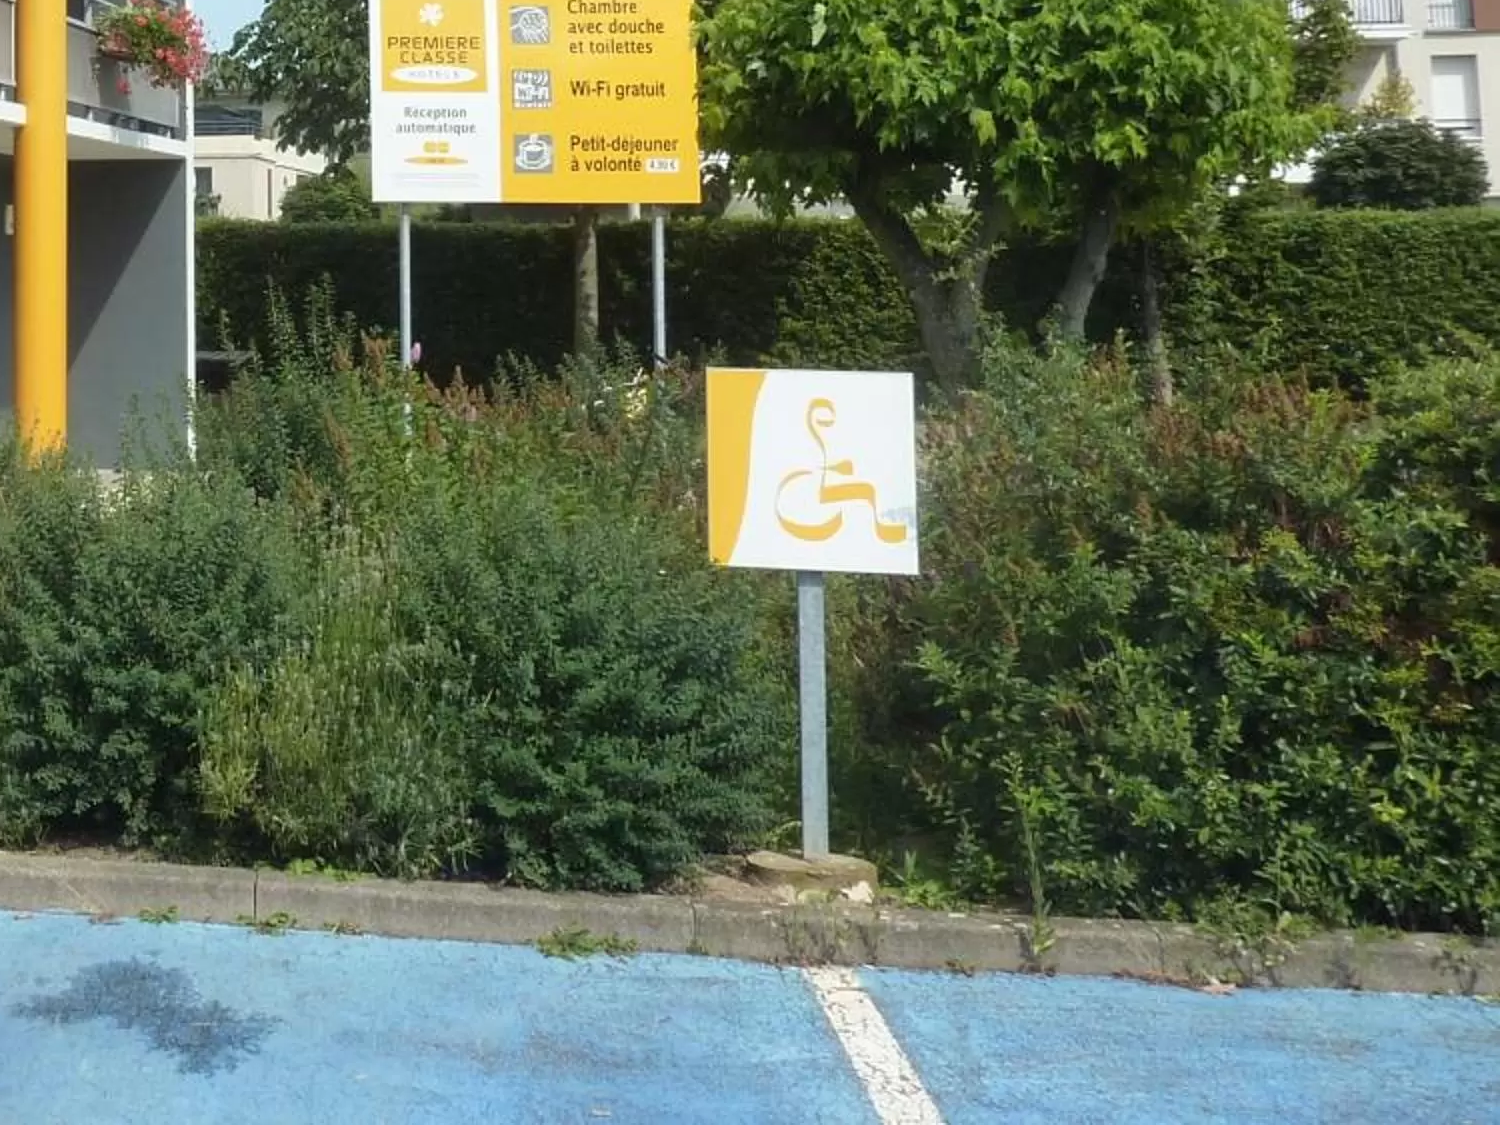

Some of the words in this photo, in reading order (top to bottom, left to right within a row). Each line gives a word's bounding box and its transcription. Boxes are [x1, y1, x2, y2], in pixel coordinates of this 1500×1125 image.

[567, 22, 603, 34] avec
[608, 18, 665, 34] douche
[387, 36, 481, 50] PREMIERE
[569, 41, 583, 54] et
[589, 39, 653, 54] toilettes
[400, 51, 468, 64] CLASSE
[570, 80, 611, 97] Wi-Fi
[615, 81, 665, 101] gratuit
[395, 122, 477, 136] automatique
[570, 134, 679, 155] Petit-déjeuner
[570, 155, 580, 172] à
[584, 155, 642, 172] volonté
